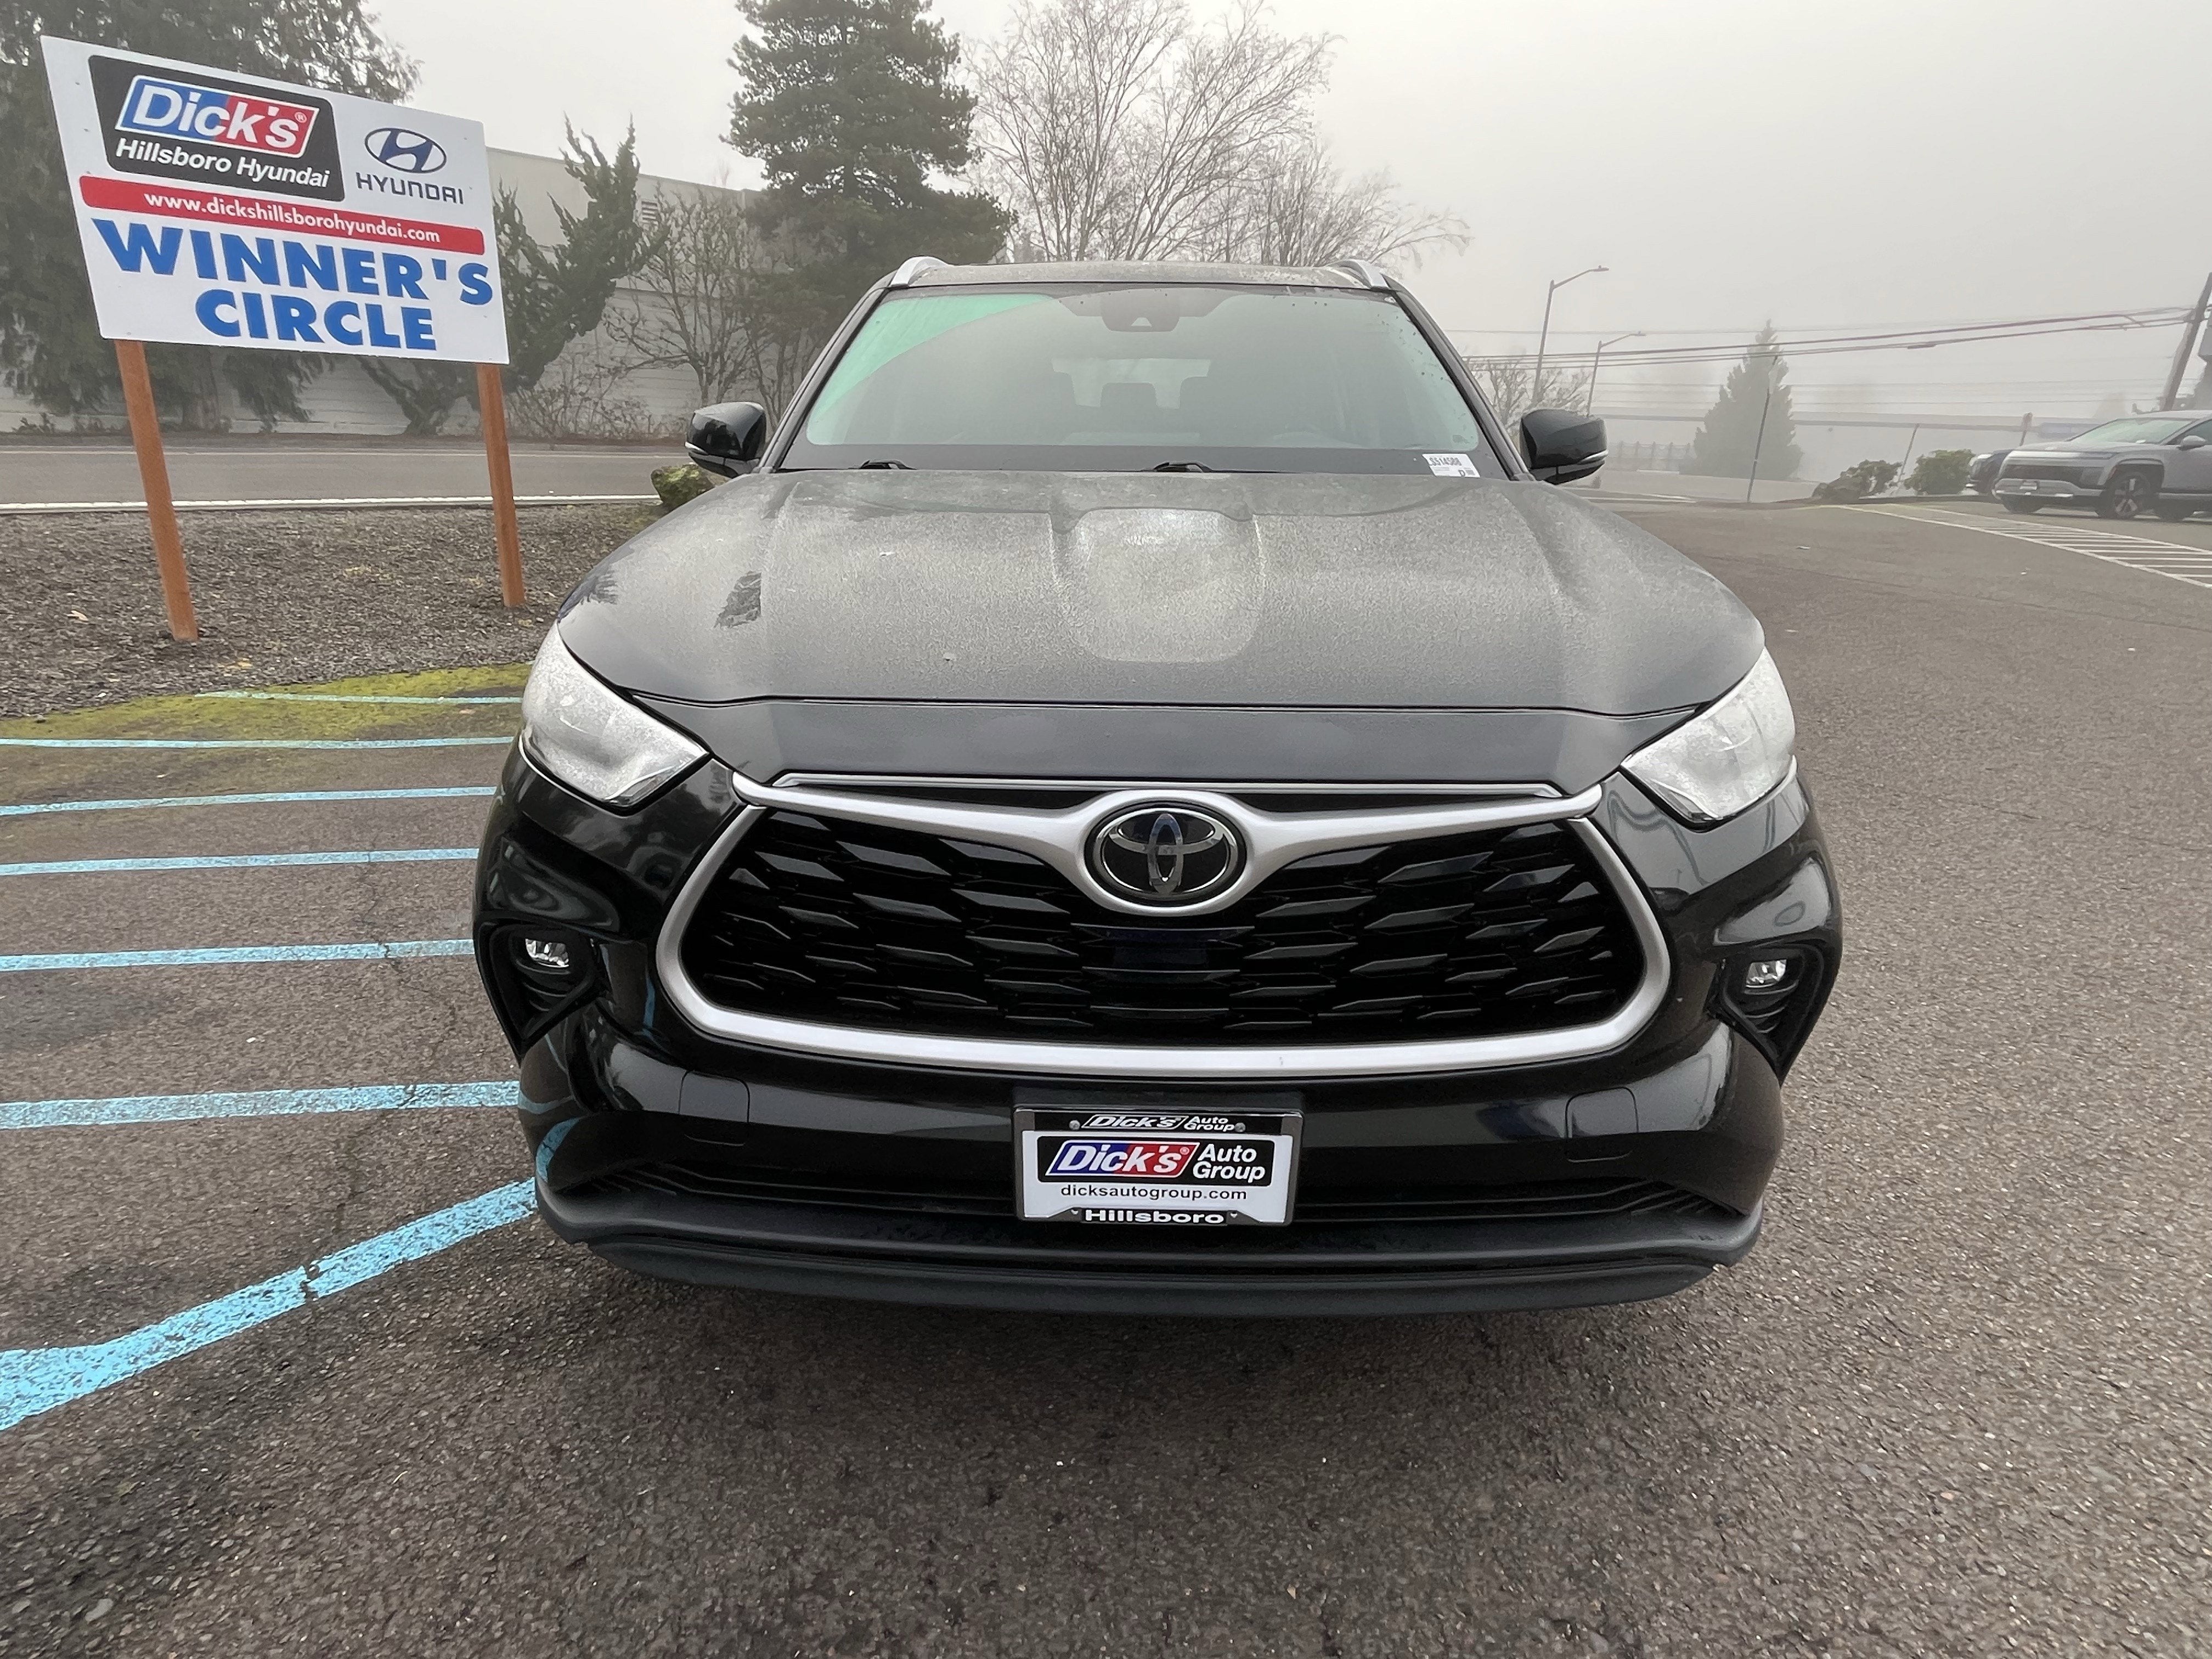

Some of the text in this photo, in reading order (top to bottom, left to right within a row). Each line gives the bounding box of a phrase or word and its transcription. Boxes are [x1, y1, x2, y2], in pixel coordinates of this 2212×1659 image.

[115, 138, 330, 192] Hillsboro Hyundai
[356, 172, 465, 205] HYUNDAI
[144, 190, 441, 244] www.dickshillsborohyundai.com
[91, 218, 493, 306] WINNER'S
[195, 289, 437, 351] CIRCLE
[1184, 1122, 1235, 1132] Group
[1188, 1116, 1228, 1125] Auto
[1198, 1143, 1257, 1163] Auto
[1193, 1162, 1266, 1183] Group
[1060, 1184, 1247, 1200] dicksautogroup.com
[1085, 1209, 1225, 1224] Hillsboro
